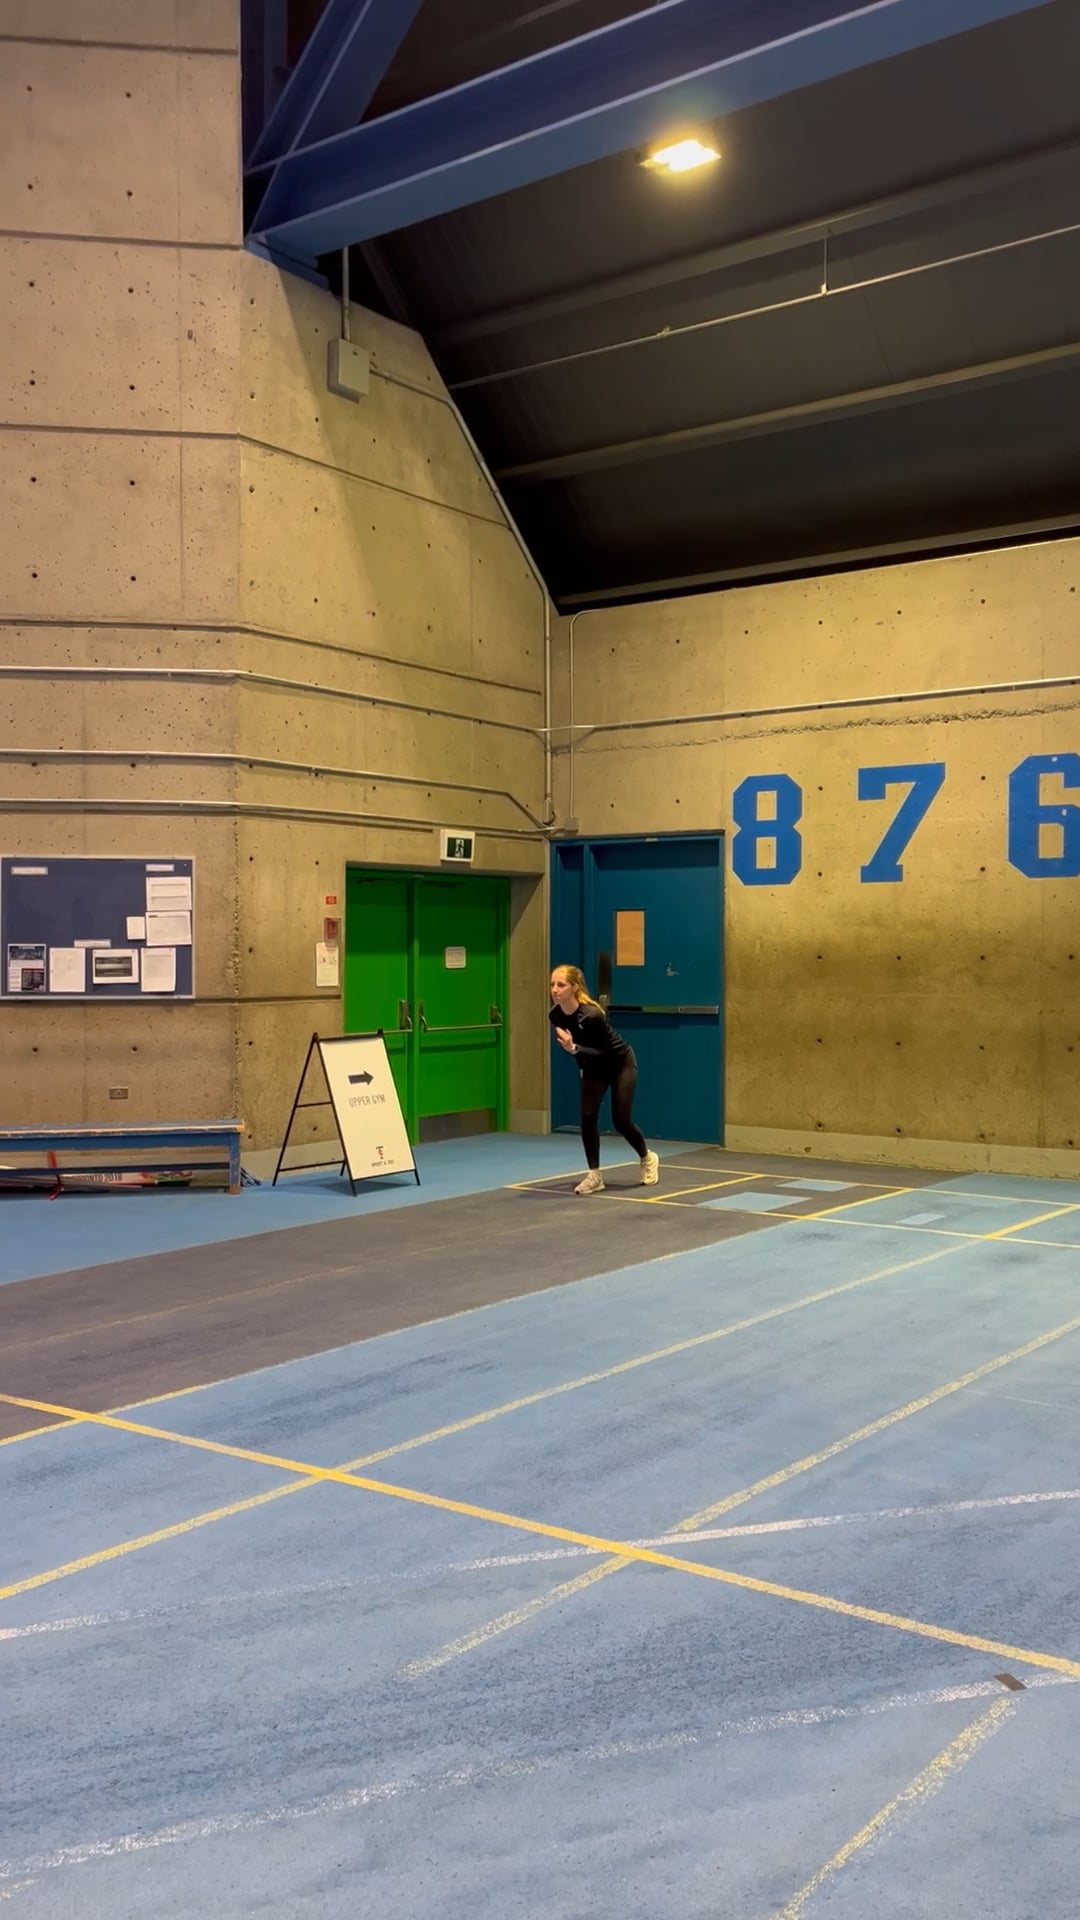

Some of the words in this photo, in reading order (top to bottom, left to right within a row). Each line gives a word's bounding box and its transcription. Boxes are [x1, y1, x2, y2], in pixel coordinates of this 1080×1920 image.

[732, 773, 803, 886] 8
[857, 761, 946, 884] 7
[1006, 753, 1080, 880] 6
[348, 1096, 371, 1107] UPPER
[371, 1094, 386, 1104] GYM
